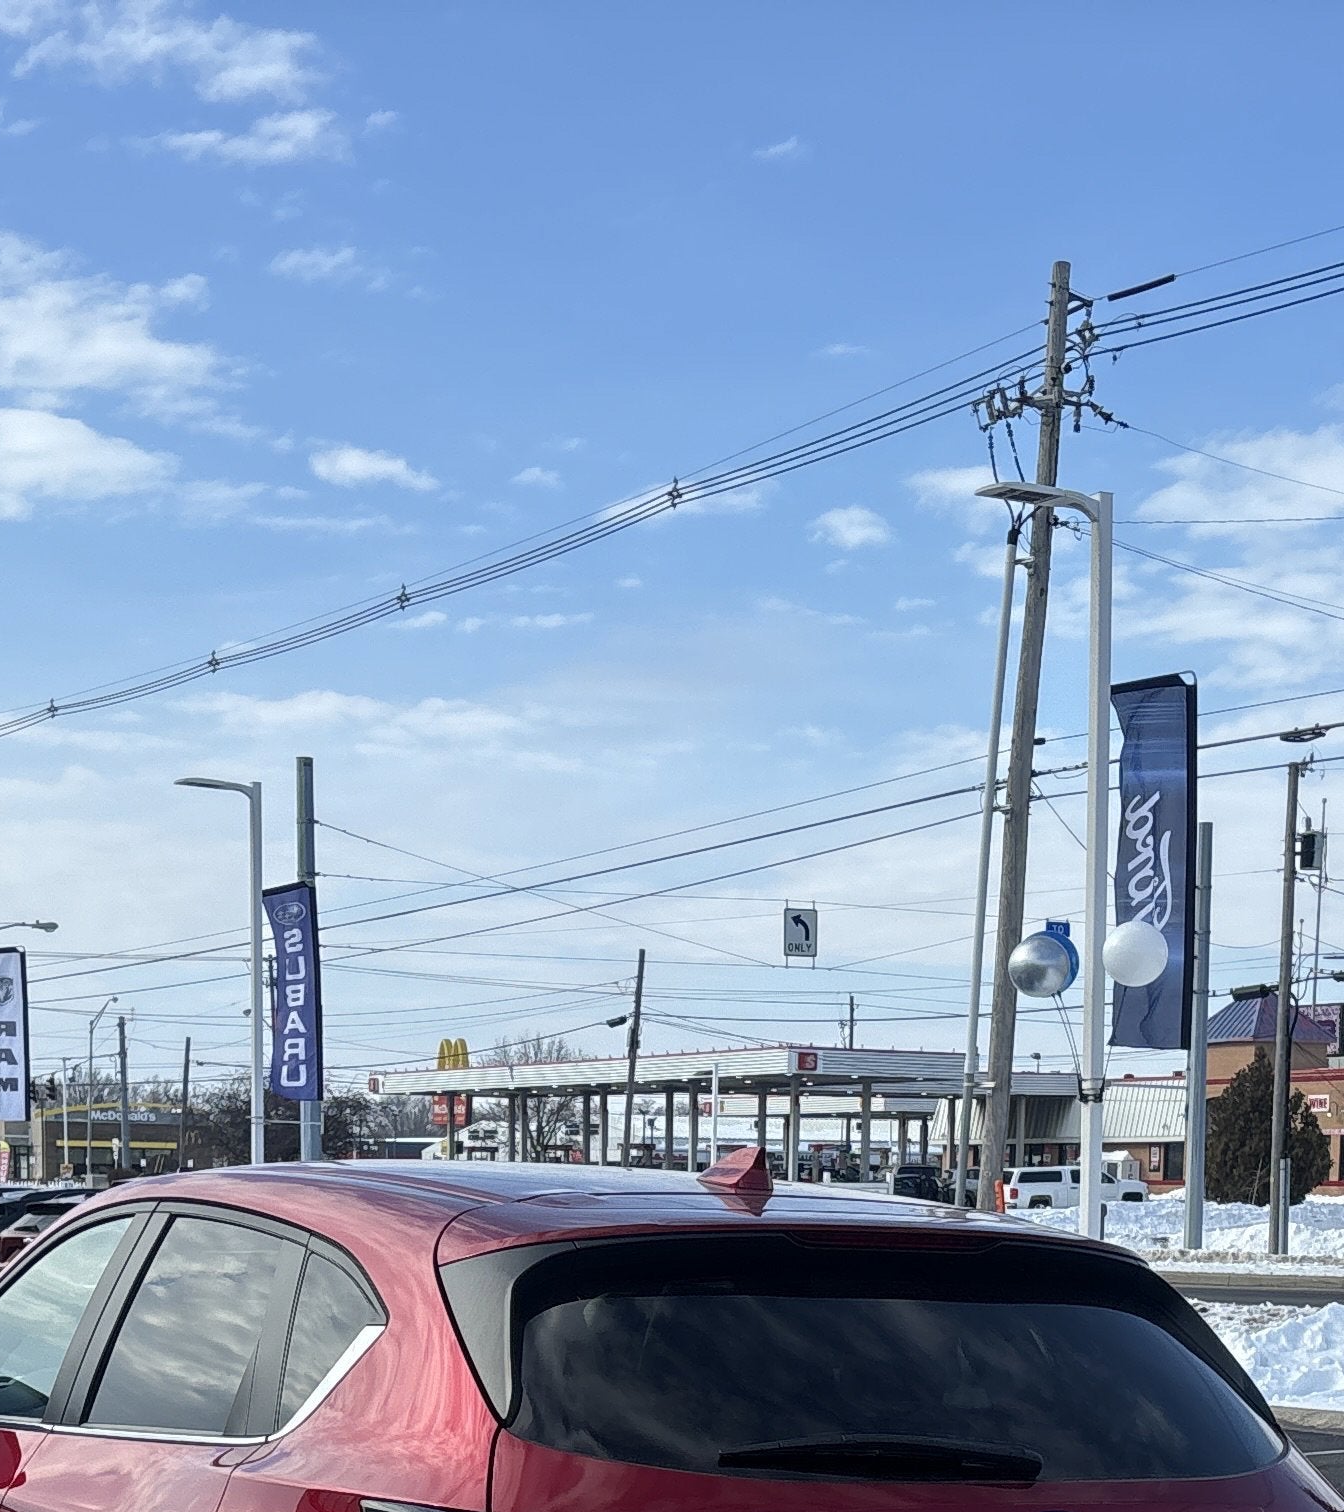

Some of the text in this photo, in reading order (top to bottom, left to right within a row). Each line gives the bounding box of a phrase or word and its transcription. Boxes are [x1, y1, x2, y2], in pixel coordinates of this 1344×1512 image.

[1051, 924, 1065, 935] TO
[787, 942, 813, 953] ONLY
[1309, 1097, 1328, 1109] WINE
